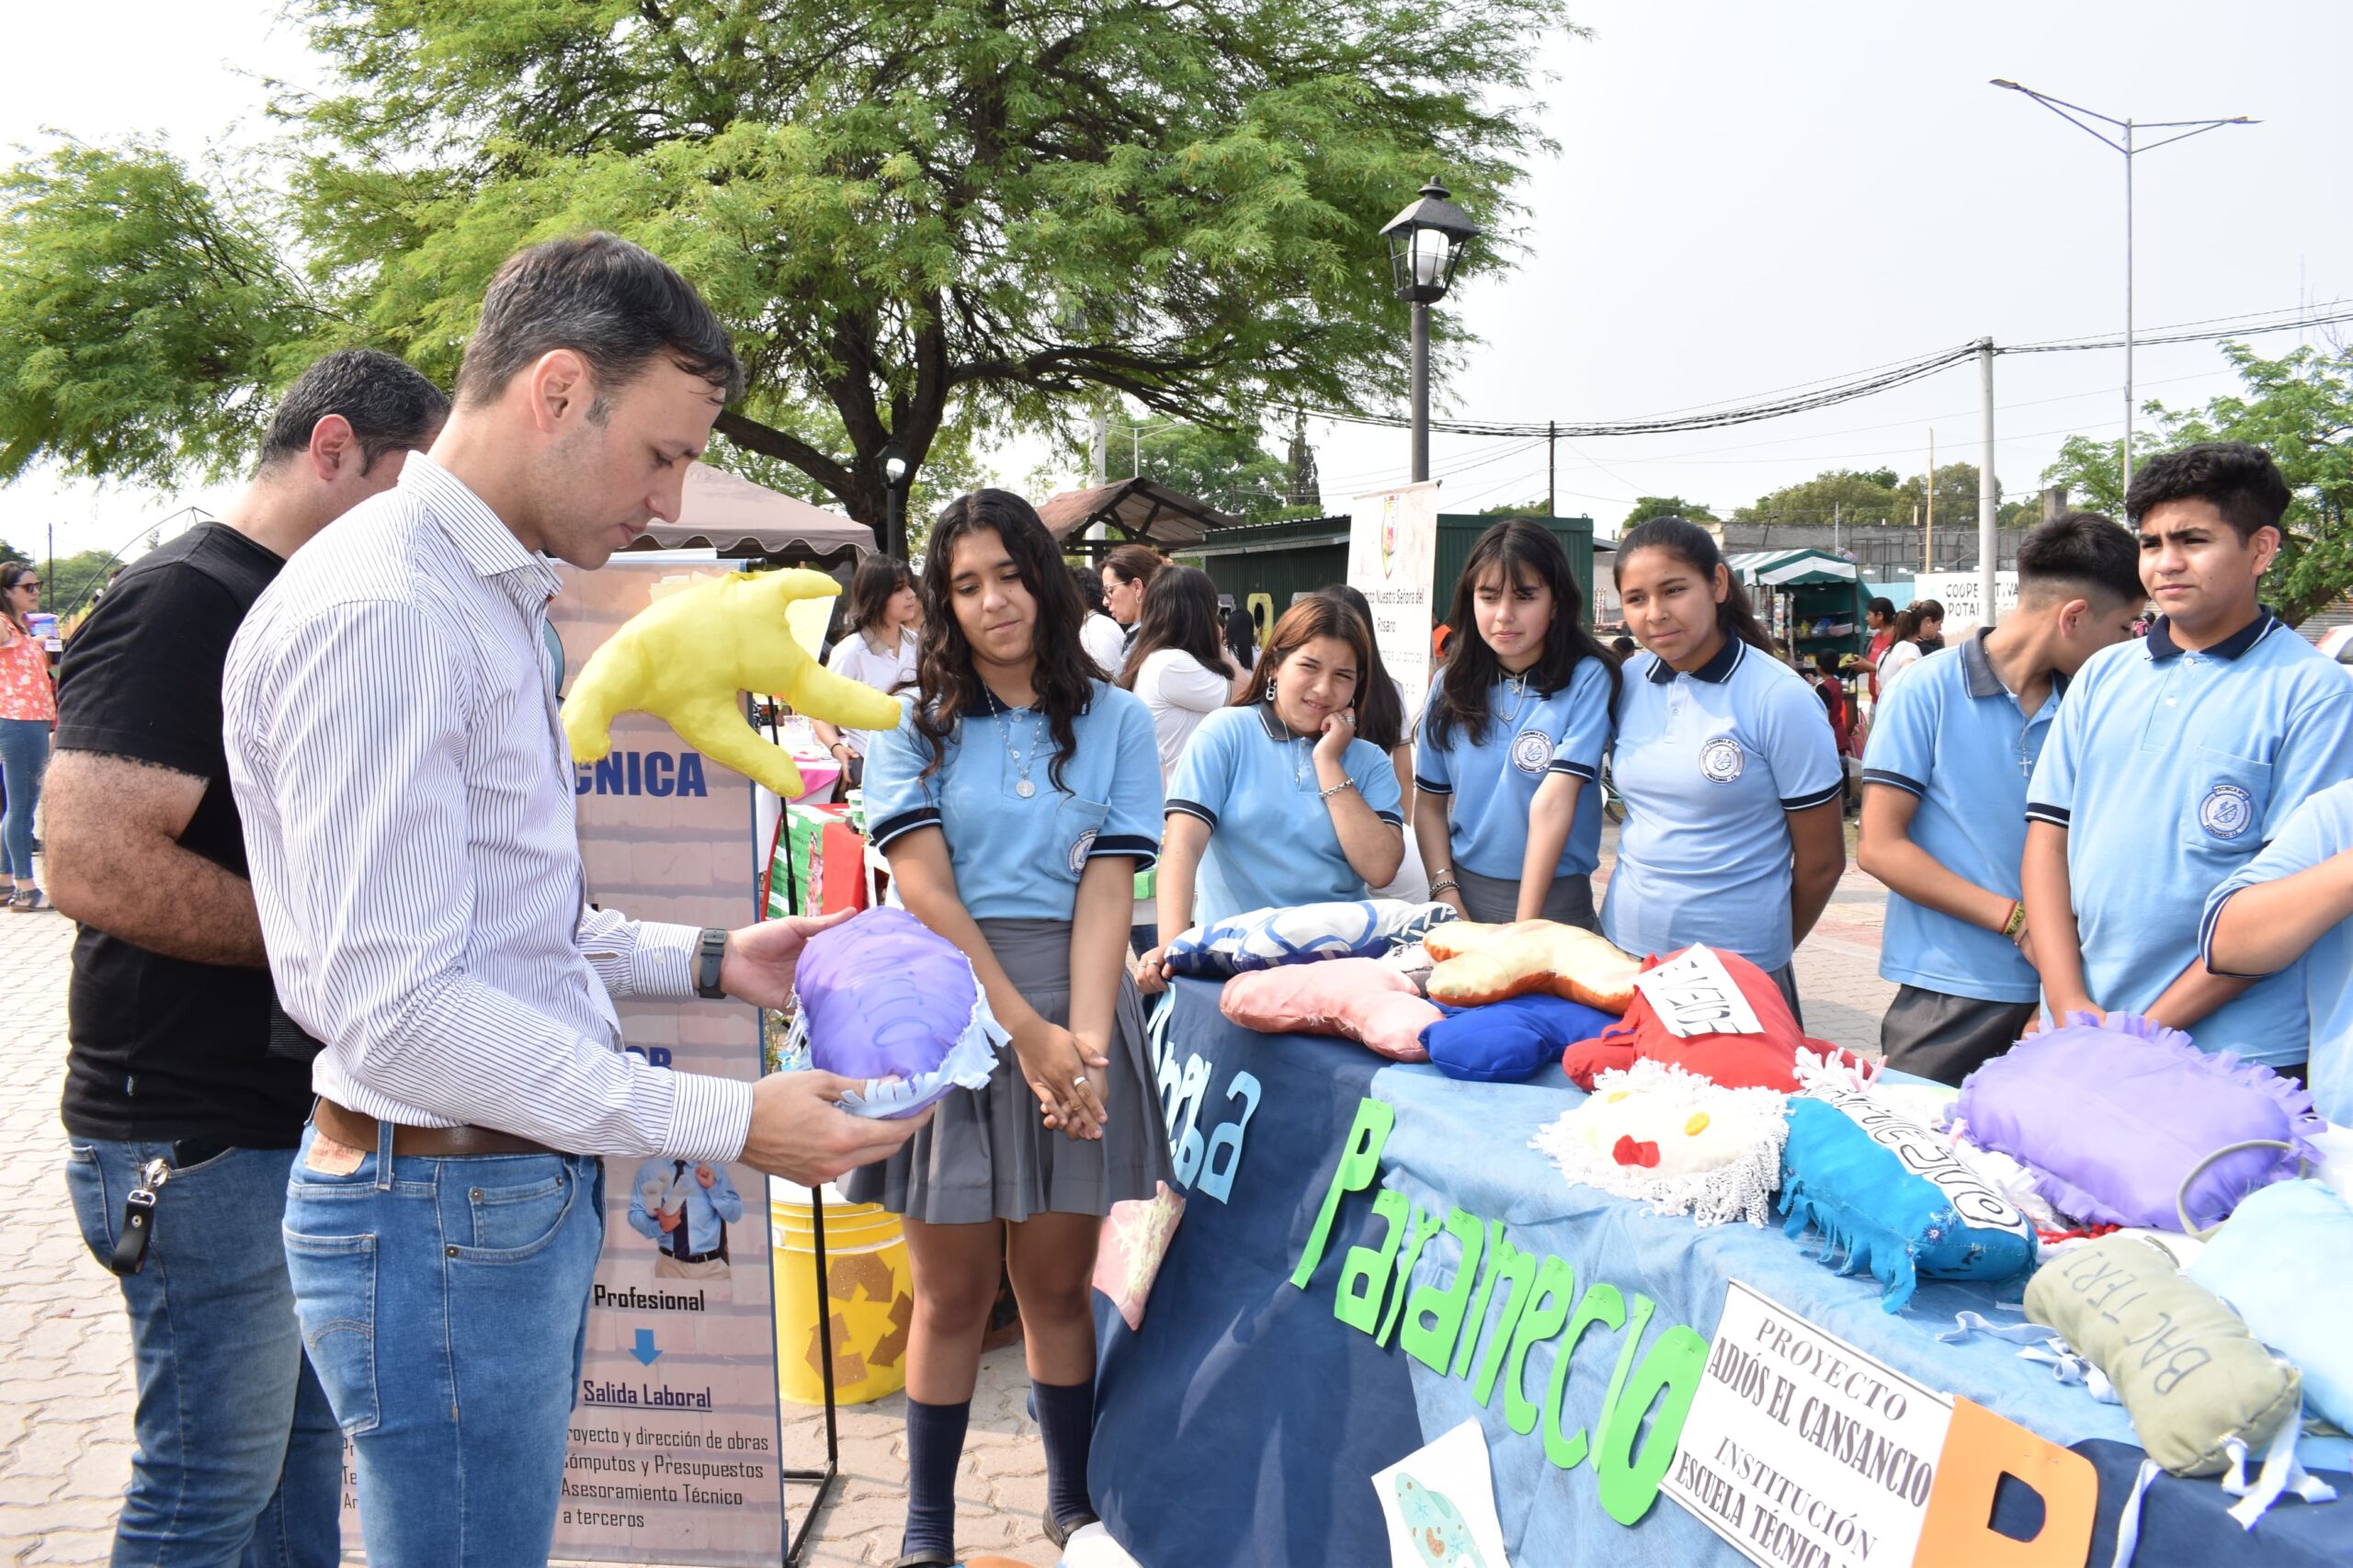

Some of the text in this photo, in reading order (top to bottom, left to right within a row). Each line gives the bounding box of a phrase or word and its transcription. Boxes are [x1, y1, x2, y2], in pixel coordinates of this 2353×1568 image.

[594, 1284, 705, 1312] Profesional
[1754, 1316, 1907, 1421] PROYECTO
[584, 1380, 711, 1408] Salida Laboral
[1707, 1336, 1770, 1407] ADIÓS
[1766, 1375, 1797, 1426] EL
[1799, 1395, 1932, 1507] CANSANCIO
[566, 1426, 768, 1450] royecto y dirección de obras
[641, 1460, 649, 1477] y
[654, 1454, 764, 1481] Presupuestos
[562, 1477, 743, 1506] Asesoramiento Técnico
[1675, 1450, 1746, 1528] ESCUELA
[1714, 1436, 1878, 1562] INSTITUCIÓN
[563, 1508, 644, 1528] a terceros
